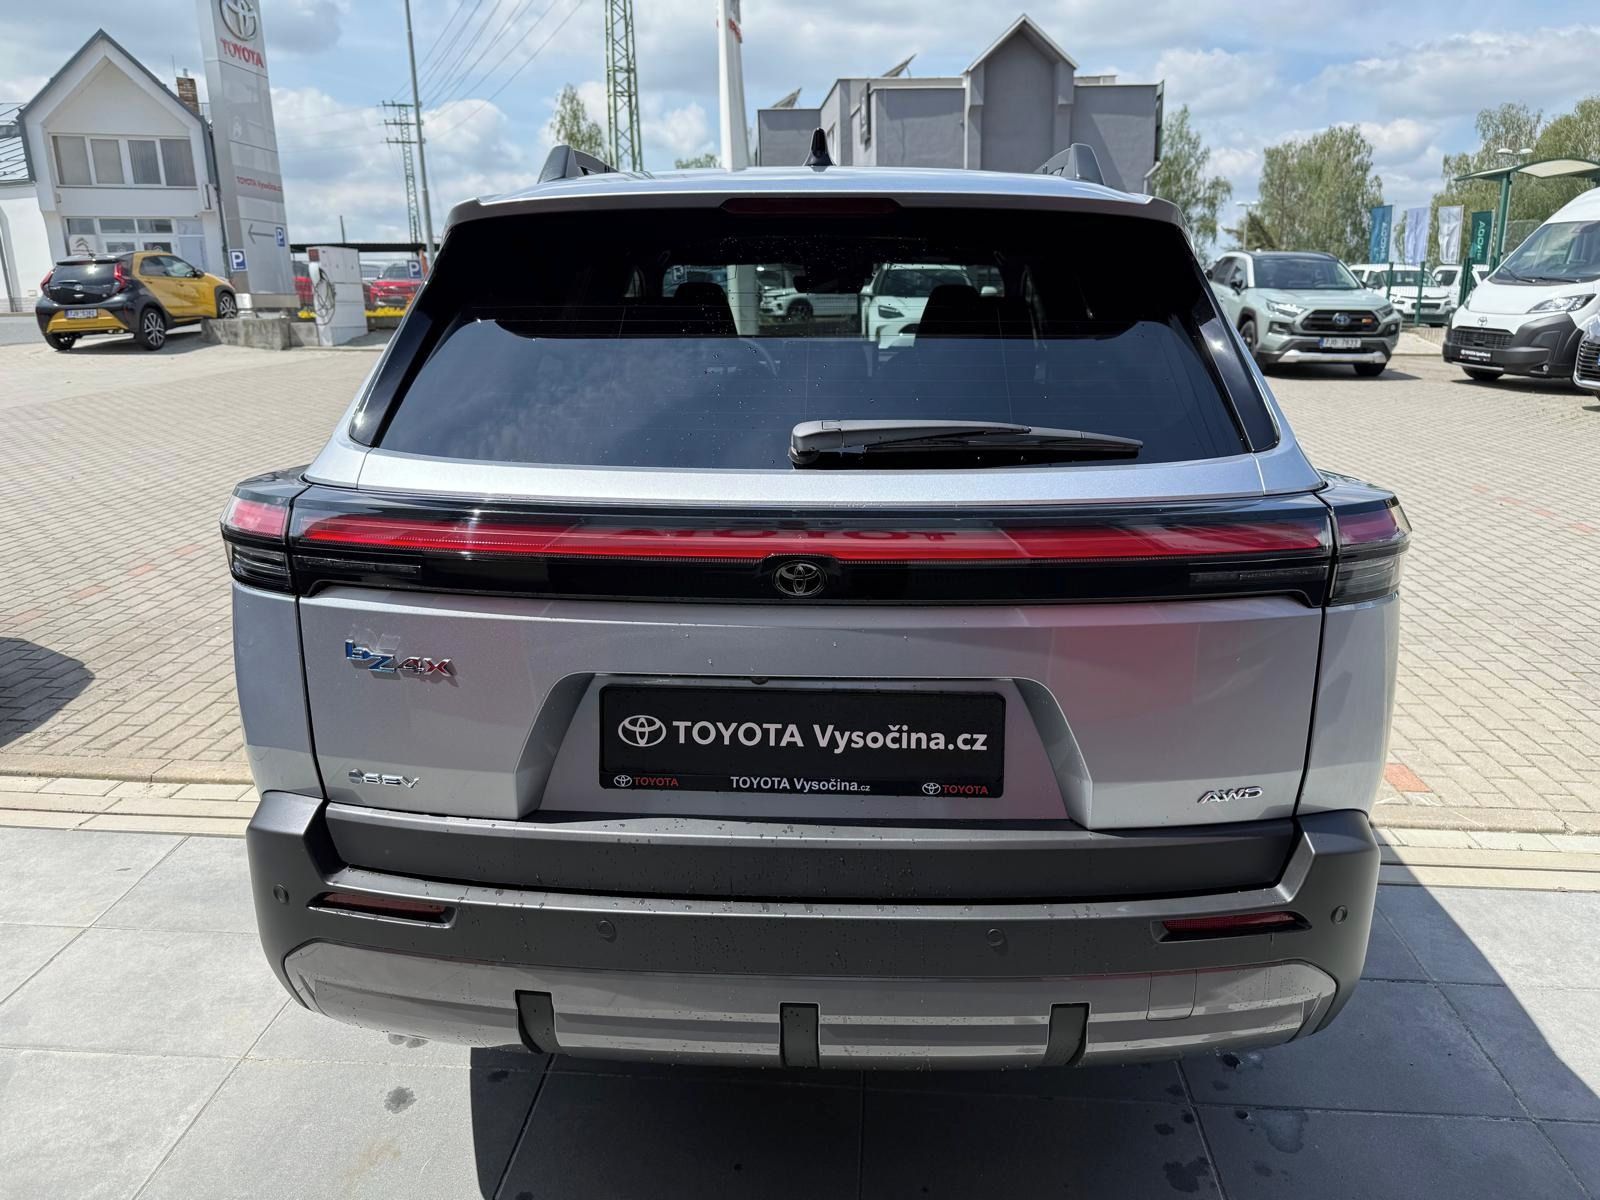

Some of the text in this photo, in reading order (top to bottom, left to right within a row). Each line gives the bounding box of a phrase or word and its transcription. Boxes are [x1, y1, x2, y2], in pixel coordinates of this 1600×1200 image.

[220, 37, 264, 69] TOYOTA
[231, 251, 244, 269] P
[409, 261, 420, 278] P
[672, 720, 988, 754] TOYOTA Vysočina.cz
[633, 776, 679, 787] TOYOTA
[730, 776, 870, 793] TOYOTA Vysočina.cz
[943, 784, 988, 795] TOYOTA
[1197, 786, 1263, 804] AWD
